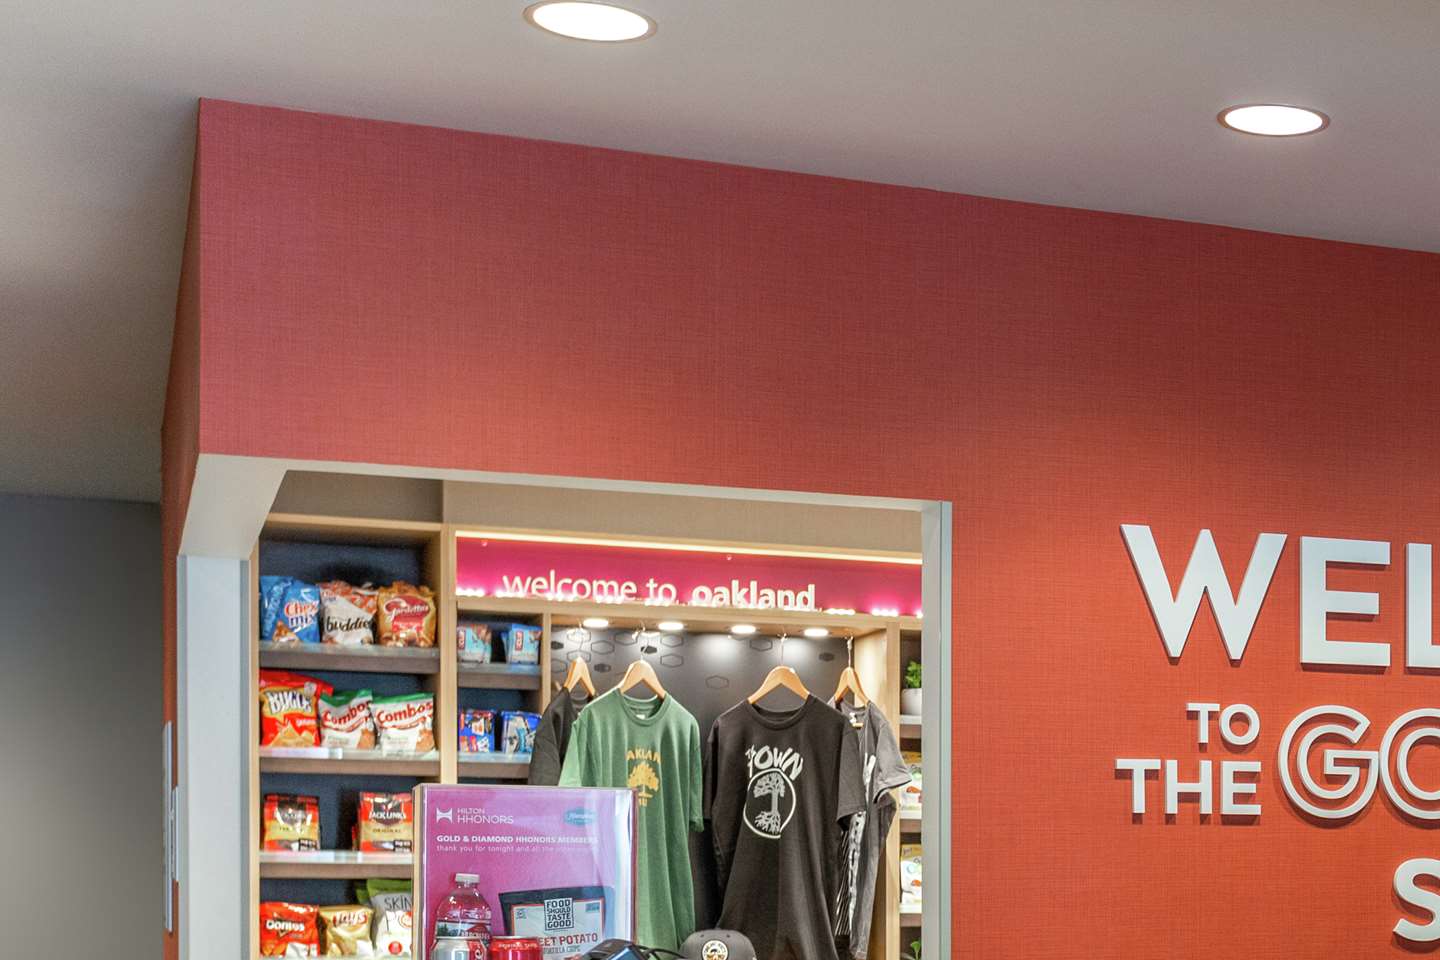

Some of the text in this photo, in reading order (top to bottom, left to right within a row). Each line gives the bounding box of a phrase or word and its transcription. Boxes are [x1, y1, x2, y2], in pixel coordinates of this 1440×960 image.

[502, 570, 816, 611] welcome to oakland
[376, 701, 433, 724] Combos
[1186, 702, 1261, 747] TO
[626, 747, 662, 763] AKLAN
[1115, 758, 1263, 817] THE
[457, 807, 486, 815] HILTON
[457, 815, 514, 824] HHONORS
[436, 835, 461, 843] GOLD
[462, 835, 469, 843] &
[472, 835, 514, 844] DIAMOND
[436, 844, 457, 852] thank
[546, 899, 572, 909] FOOD
[546, 906, 572, 915] SHOULD
[546, 912, 572, 922] TASTE
[547, 919, 572, 929] GOOD
[538, 933, 598, 947] EET POTATO
